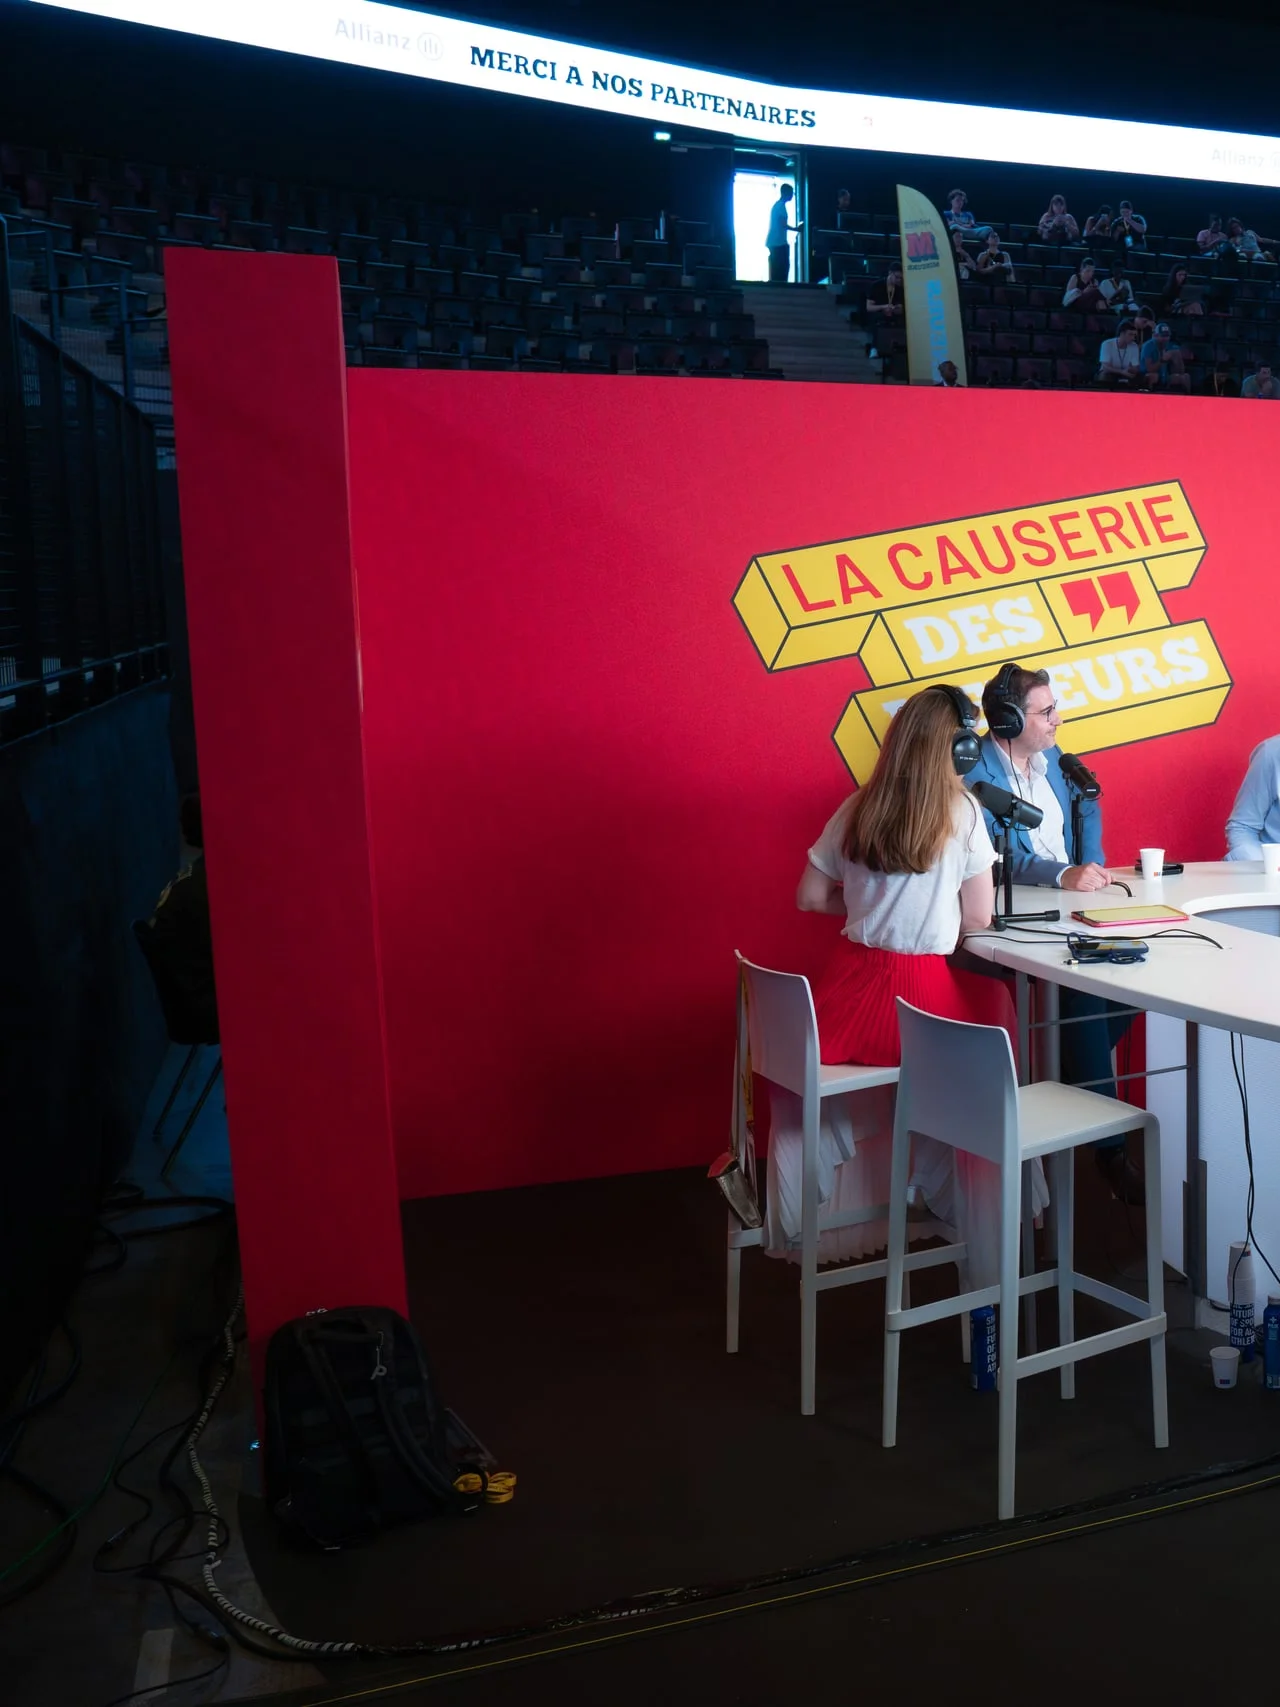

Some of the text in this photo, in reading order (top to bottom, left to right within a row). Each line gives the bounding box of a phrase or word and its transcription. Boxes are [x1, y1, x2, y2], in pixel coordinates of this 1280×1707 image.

[335, 18, 411, 50] Allianz
[470, 46, 557, 80] MERCI
[592, 70, 643, 97] NOS
[650, 82, 816, 128] PARTENAIRES
[782, 494, 1189, 612] LA CAUSERIE
[904, 596, 1045, 665] DES
